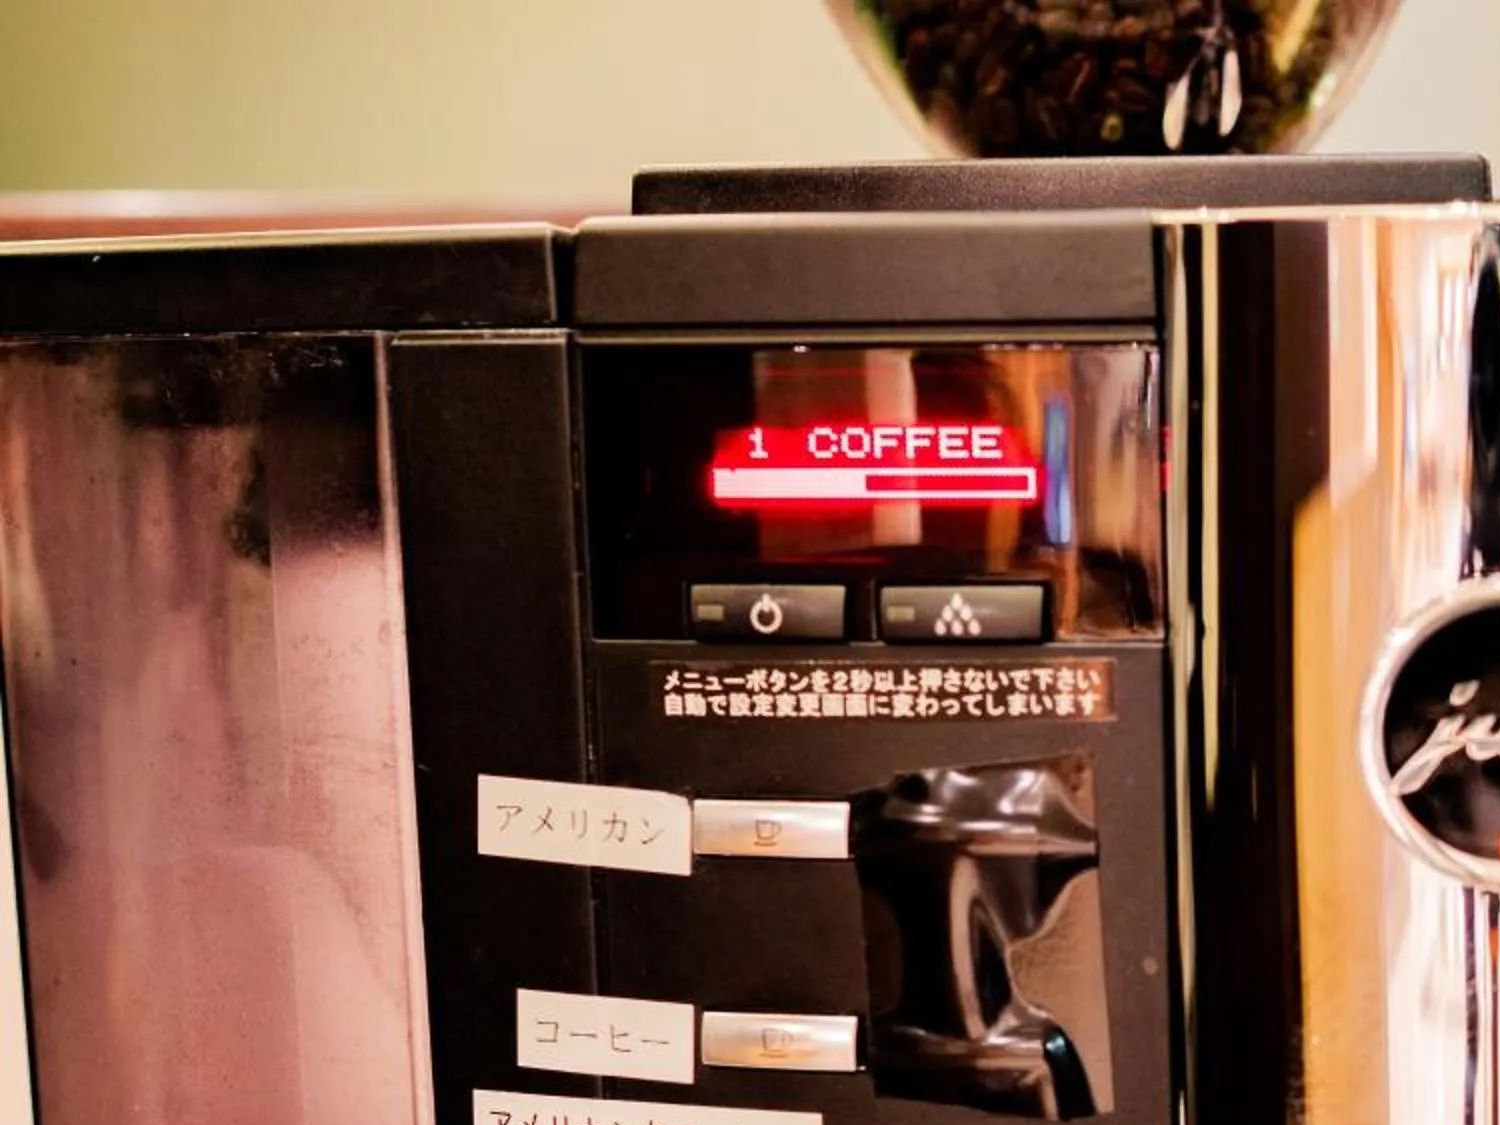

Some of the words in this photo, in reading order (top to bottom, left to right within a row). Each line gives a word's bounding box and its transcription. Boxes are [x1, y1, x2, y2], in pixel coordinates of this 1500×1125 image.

[749, 428, 768, 459] 1
[808, 427, 1003, 459] COFFEE
[496, 804, 665, 845] アメリカン
[535, 1020, 671, 1053] コーヒー
